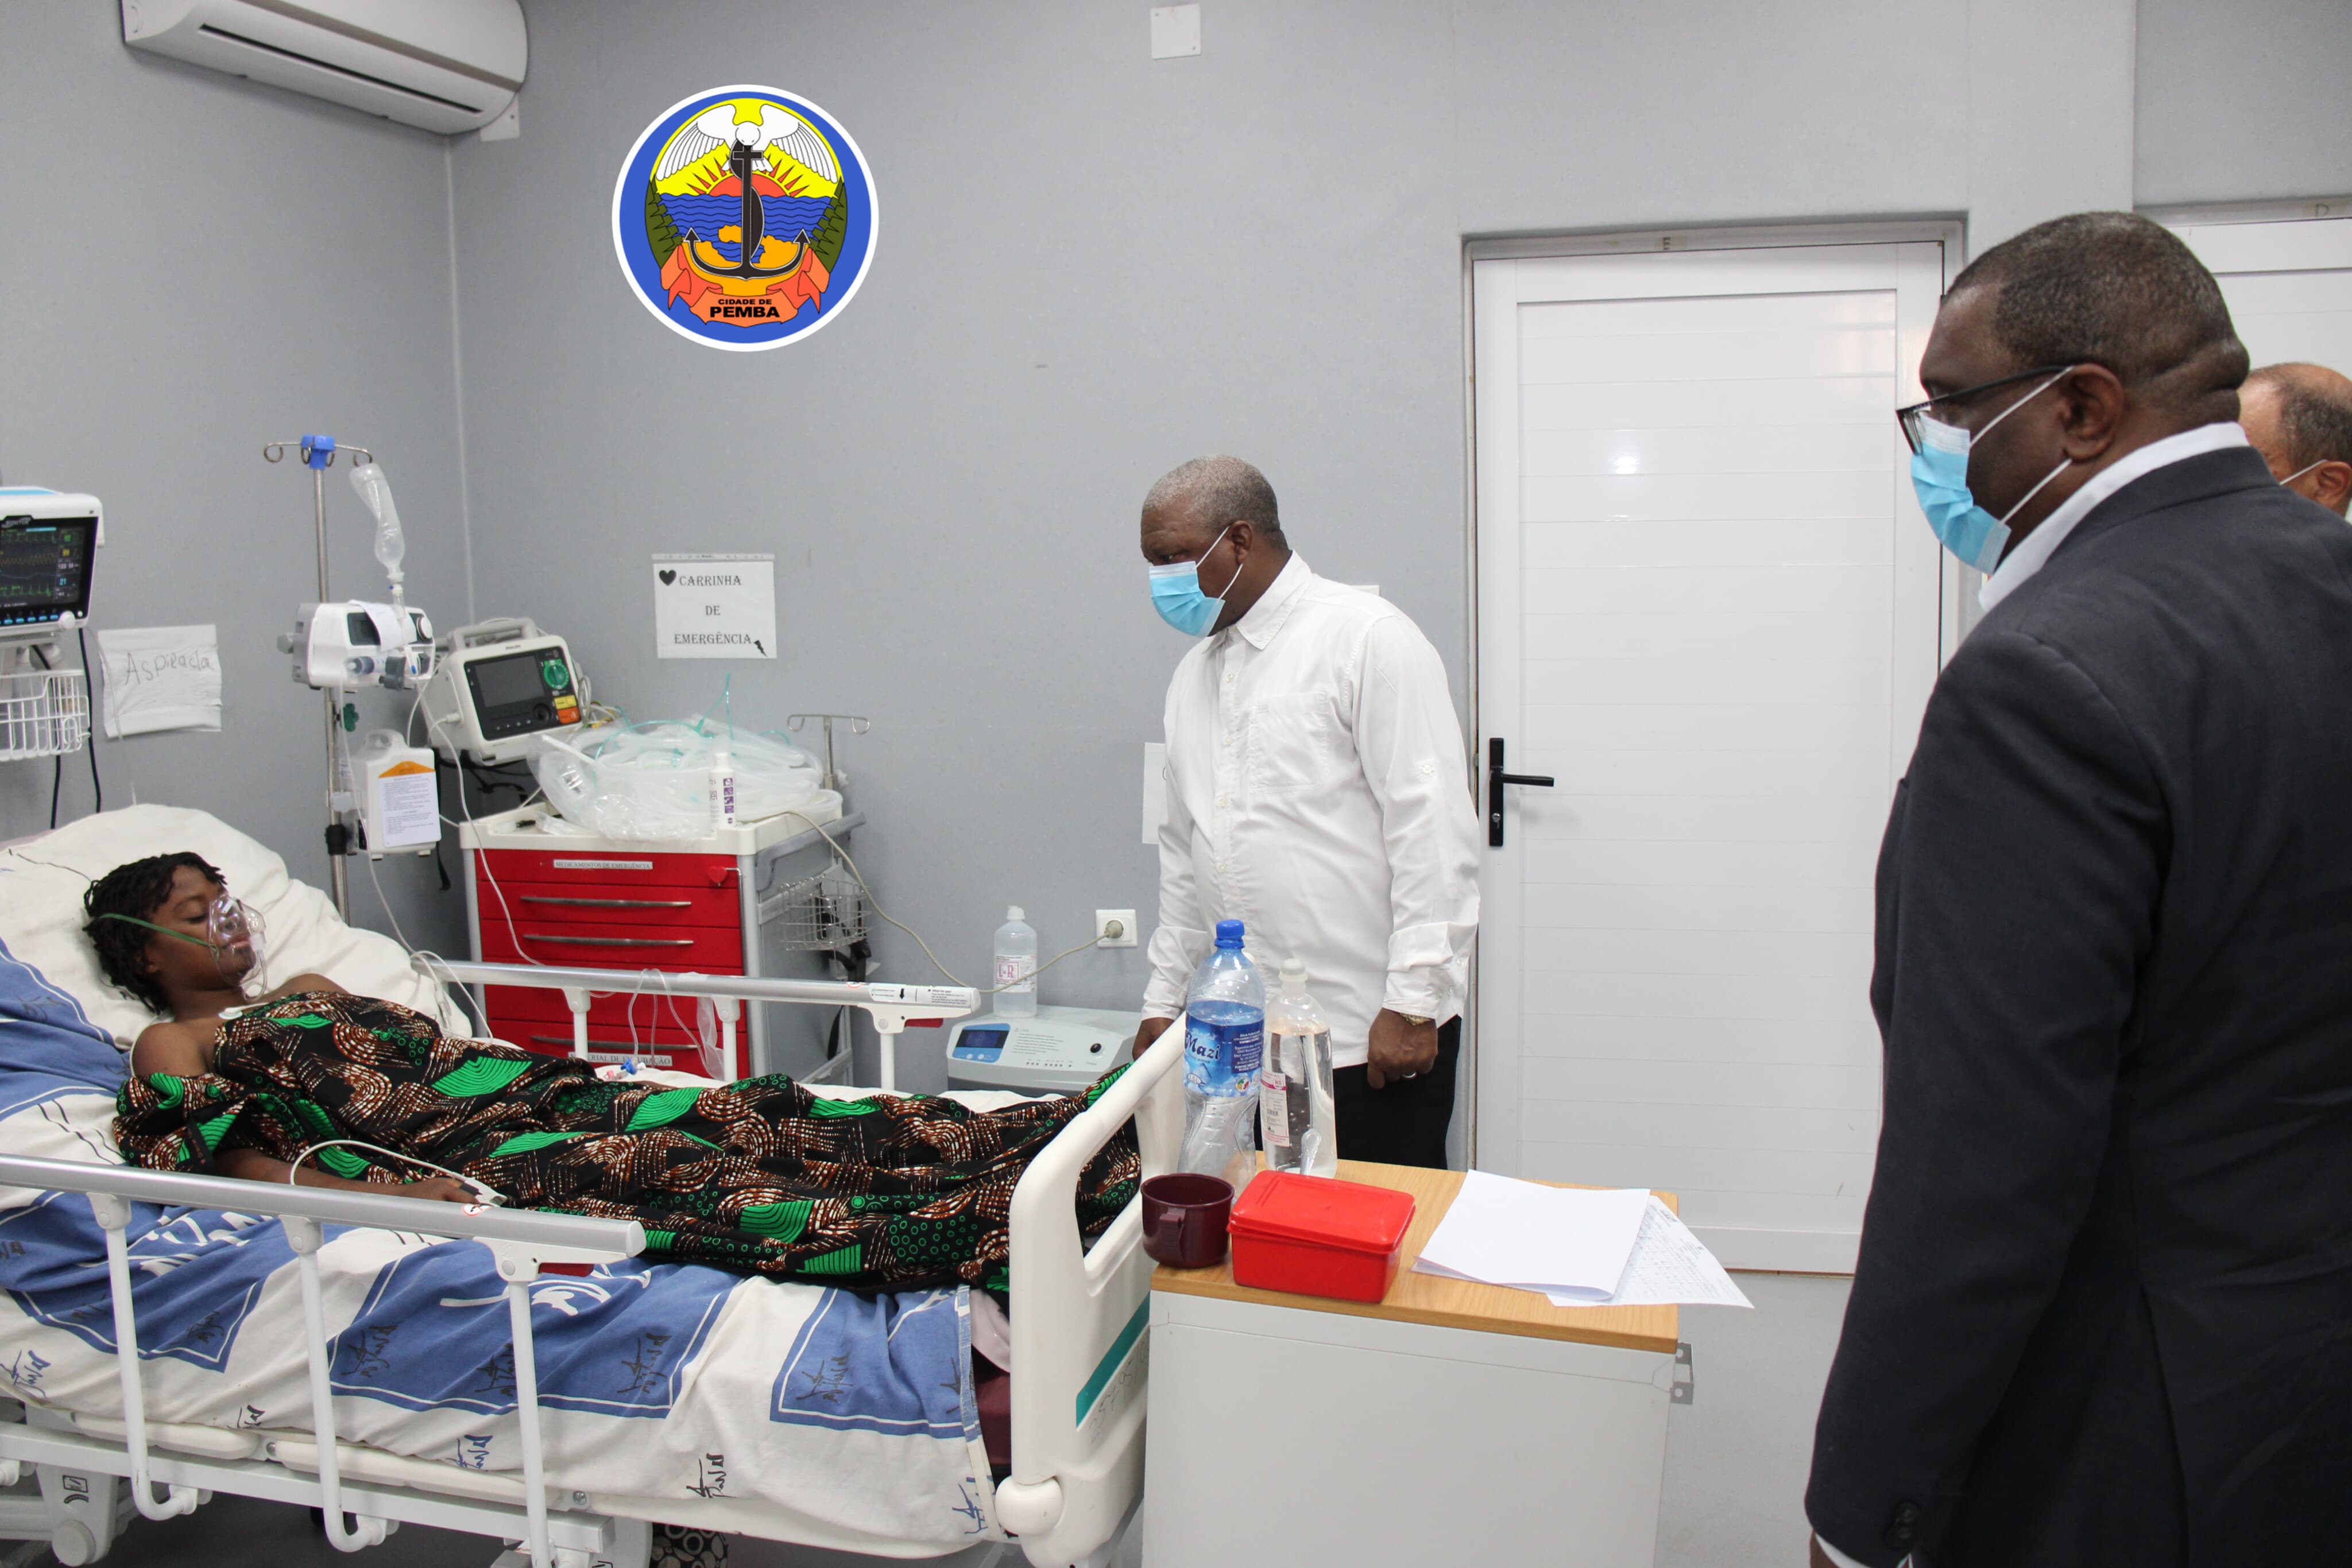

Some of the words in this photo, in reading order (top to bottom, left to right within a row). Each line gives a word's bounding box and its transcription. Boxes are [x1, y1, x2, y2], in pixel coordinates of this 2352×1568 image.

[679, 575, 741, 586] CARRINHA
[705, 605, 721, 616] DE
[674, 631, 752, 645] EMERGÊNCIA
[1185, 1031, 1221, 1060] Mazi
